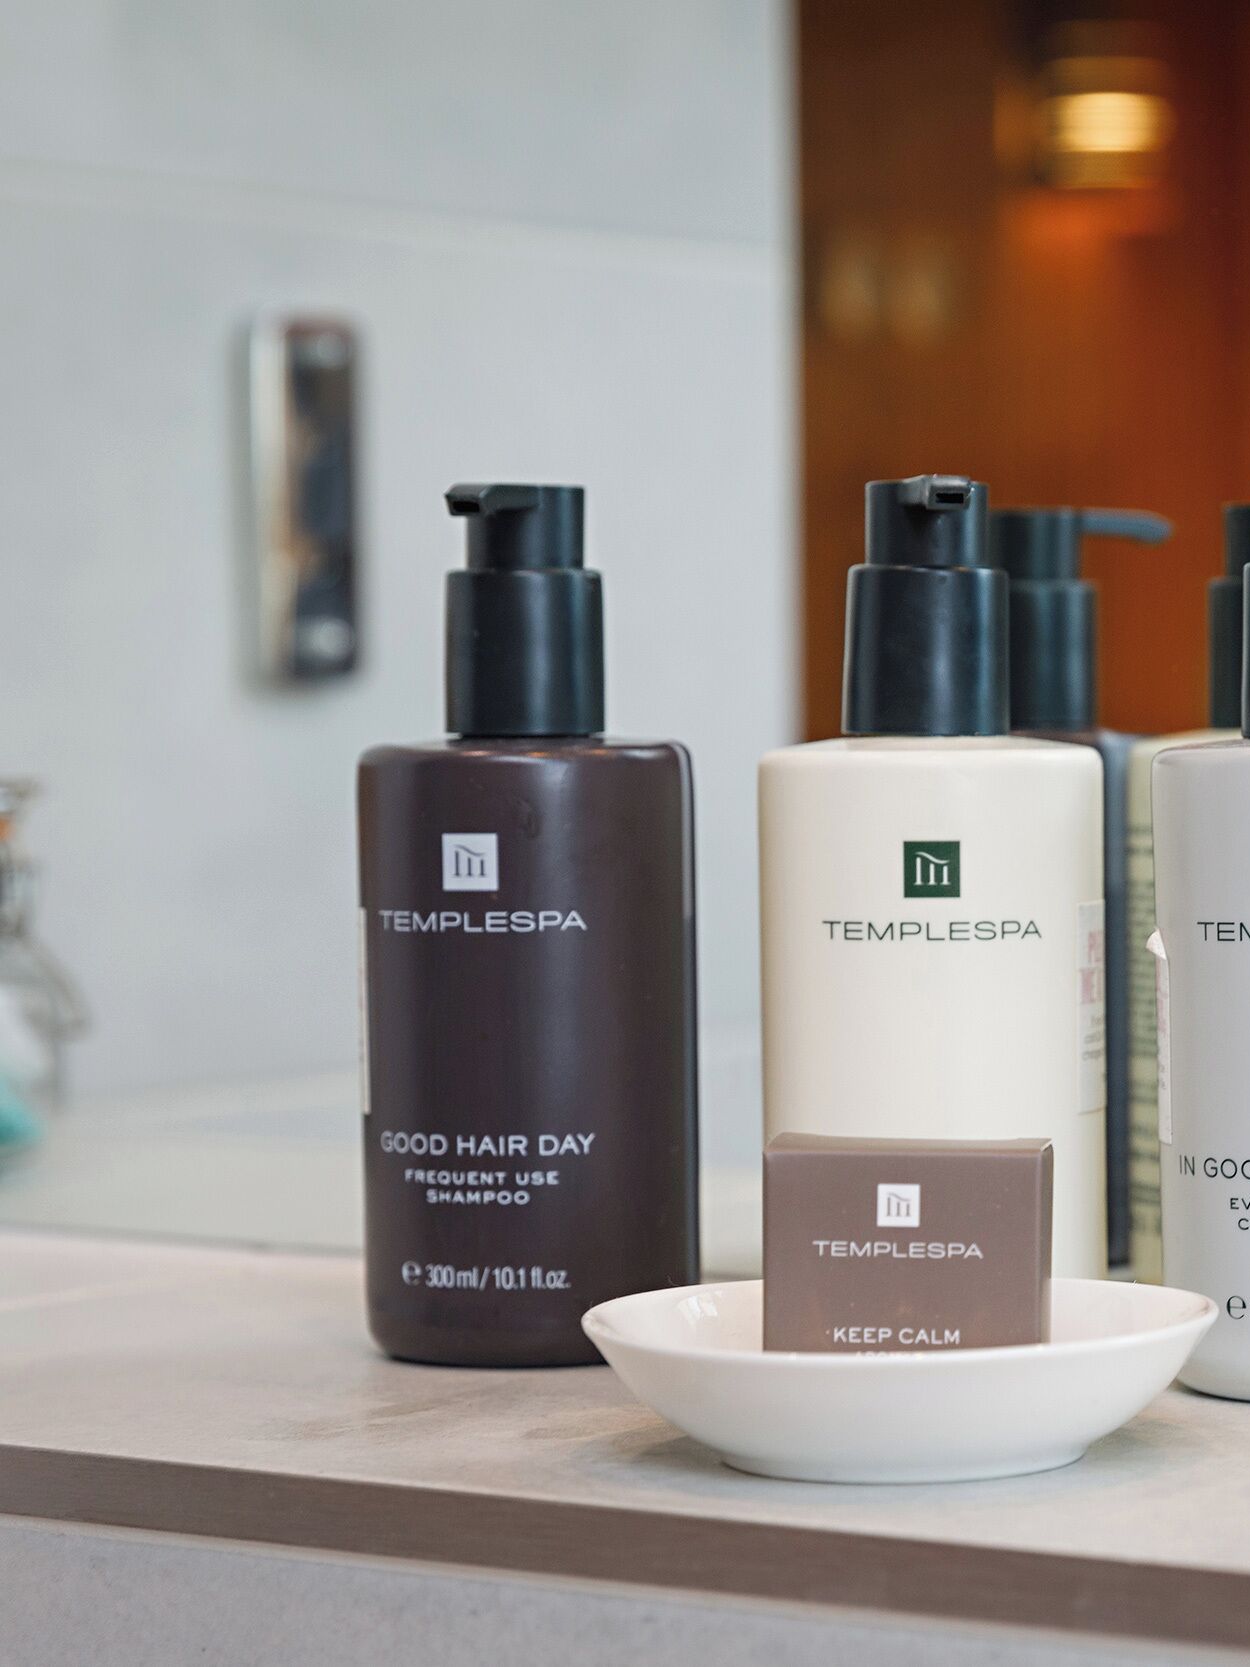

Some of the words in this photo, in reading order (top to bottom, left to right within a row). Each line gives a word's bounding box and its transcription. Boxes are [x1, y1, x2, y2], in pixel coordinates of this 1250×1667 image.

[380, 911, 586, 932] TEMPLESPA
[823, 921, 1041, 941] TEMPLESPA
[381, 1131, 448, 1155] GOOD
[457, 1135, 527, 1155] HAIR
[539, 1133, 595, 1156] DAY
[1180, 1155, 1195, 1176] IN
[405, 1169, 505, 1185] FREQUENT
[516, 1171, 558, 1185] USE
[427, 1190, 529, 1205] SHAMPOO
[813, 1241, 983, 1258] TEMPLESPA
[834, 1327, 892, 1344] KEEP
[899, 1328, 959, 1345] CALM
